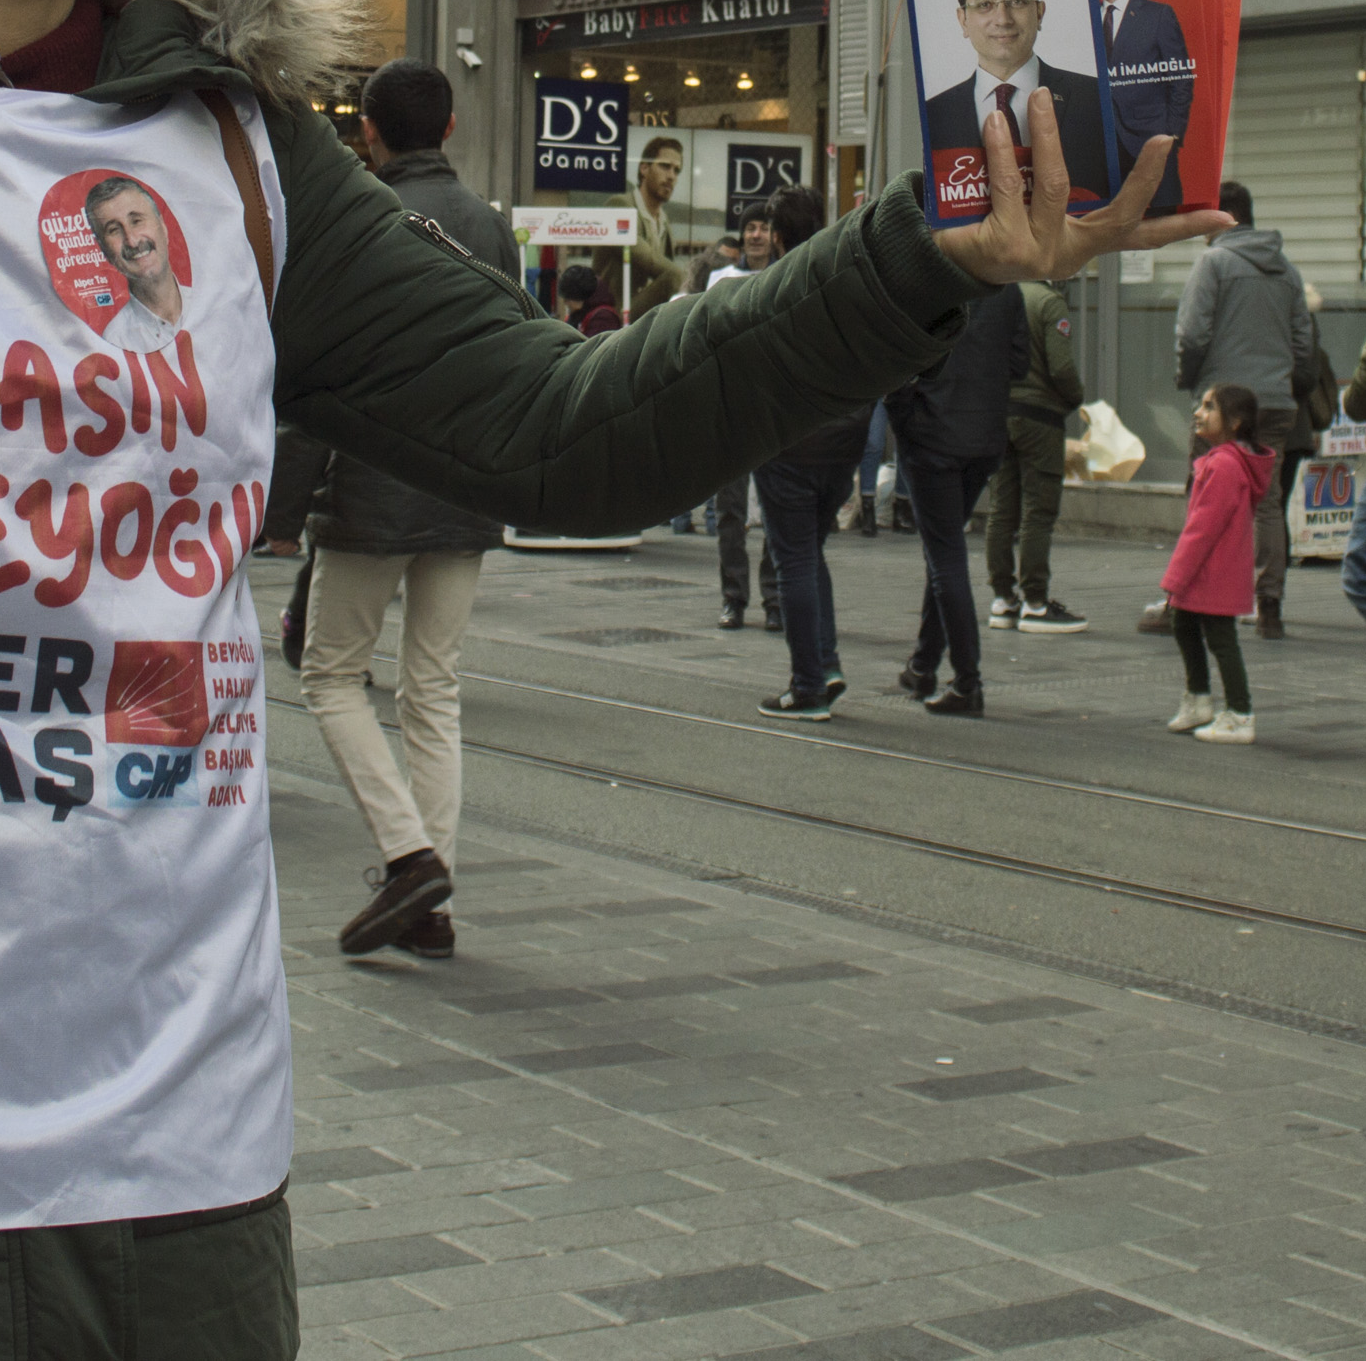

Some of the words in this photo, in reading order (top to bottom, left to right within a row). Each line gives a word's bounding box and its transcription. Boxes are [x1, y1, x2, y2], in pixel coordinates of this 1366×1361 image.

[1120, 57, 1197, 76] İMAMOĞLU
[1109, 79, 1136, 87] üyükşehir
[539, 96, 620, 146] D'S
[539, 148, 618, 172] damat
[41, 206, 91, 244] güzel
[548, 222, 609, 237] İMAMOĞLU
[58, 231, 97, 255] günler
[56, 249, 107, 273] göreceğiz
[73, 275, 95, 289] Alper
[96, 293, 112, 305] CHP
[1308, 463, 1352, 507] 70
[205, 748, 255, 776] BAŞKAN
[115, 751, 193, 800] CHP
[207, 784, 247, 808] ADAYI
